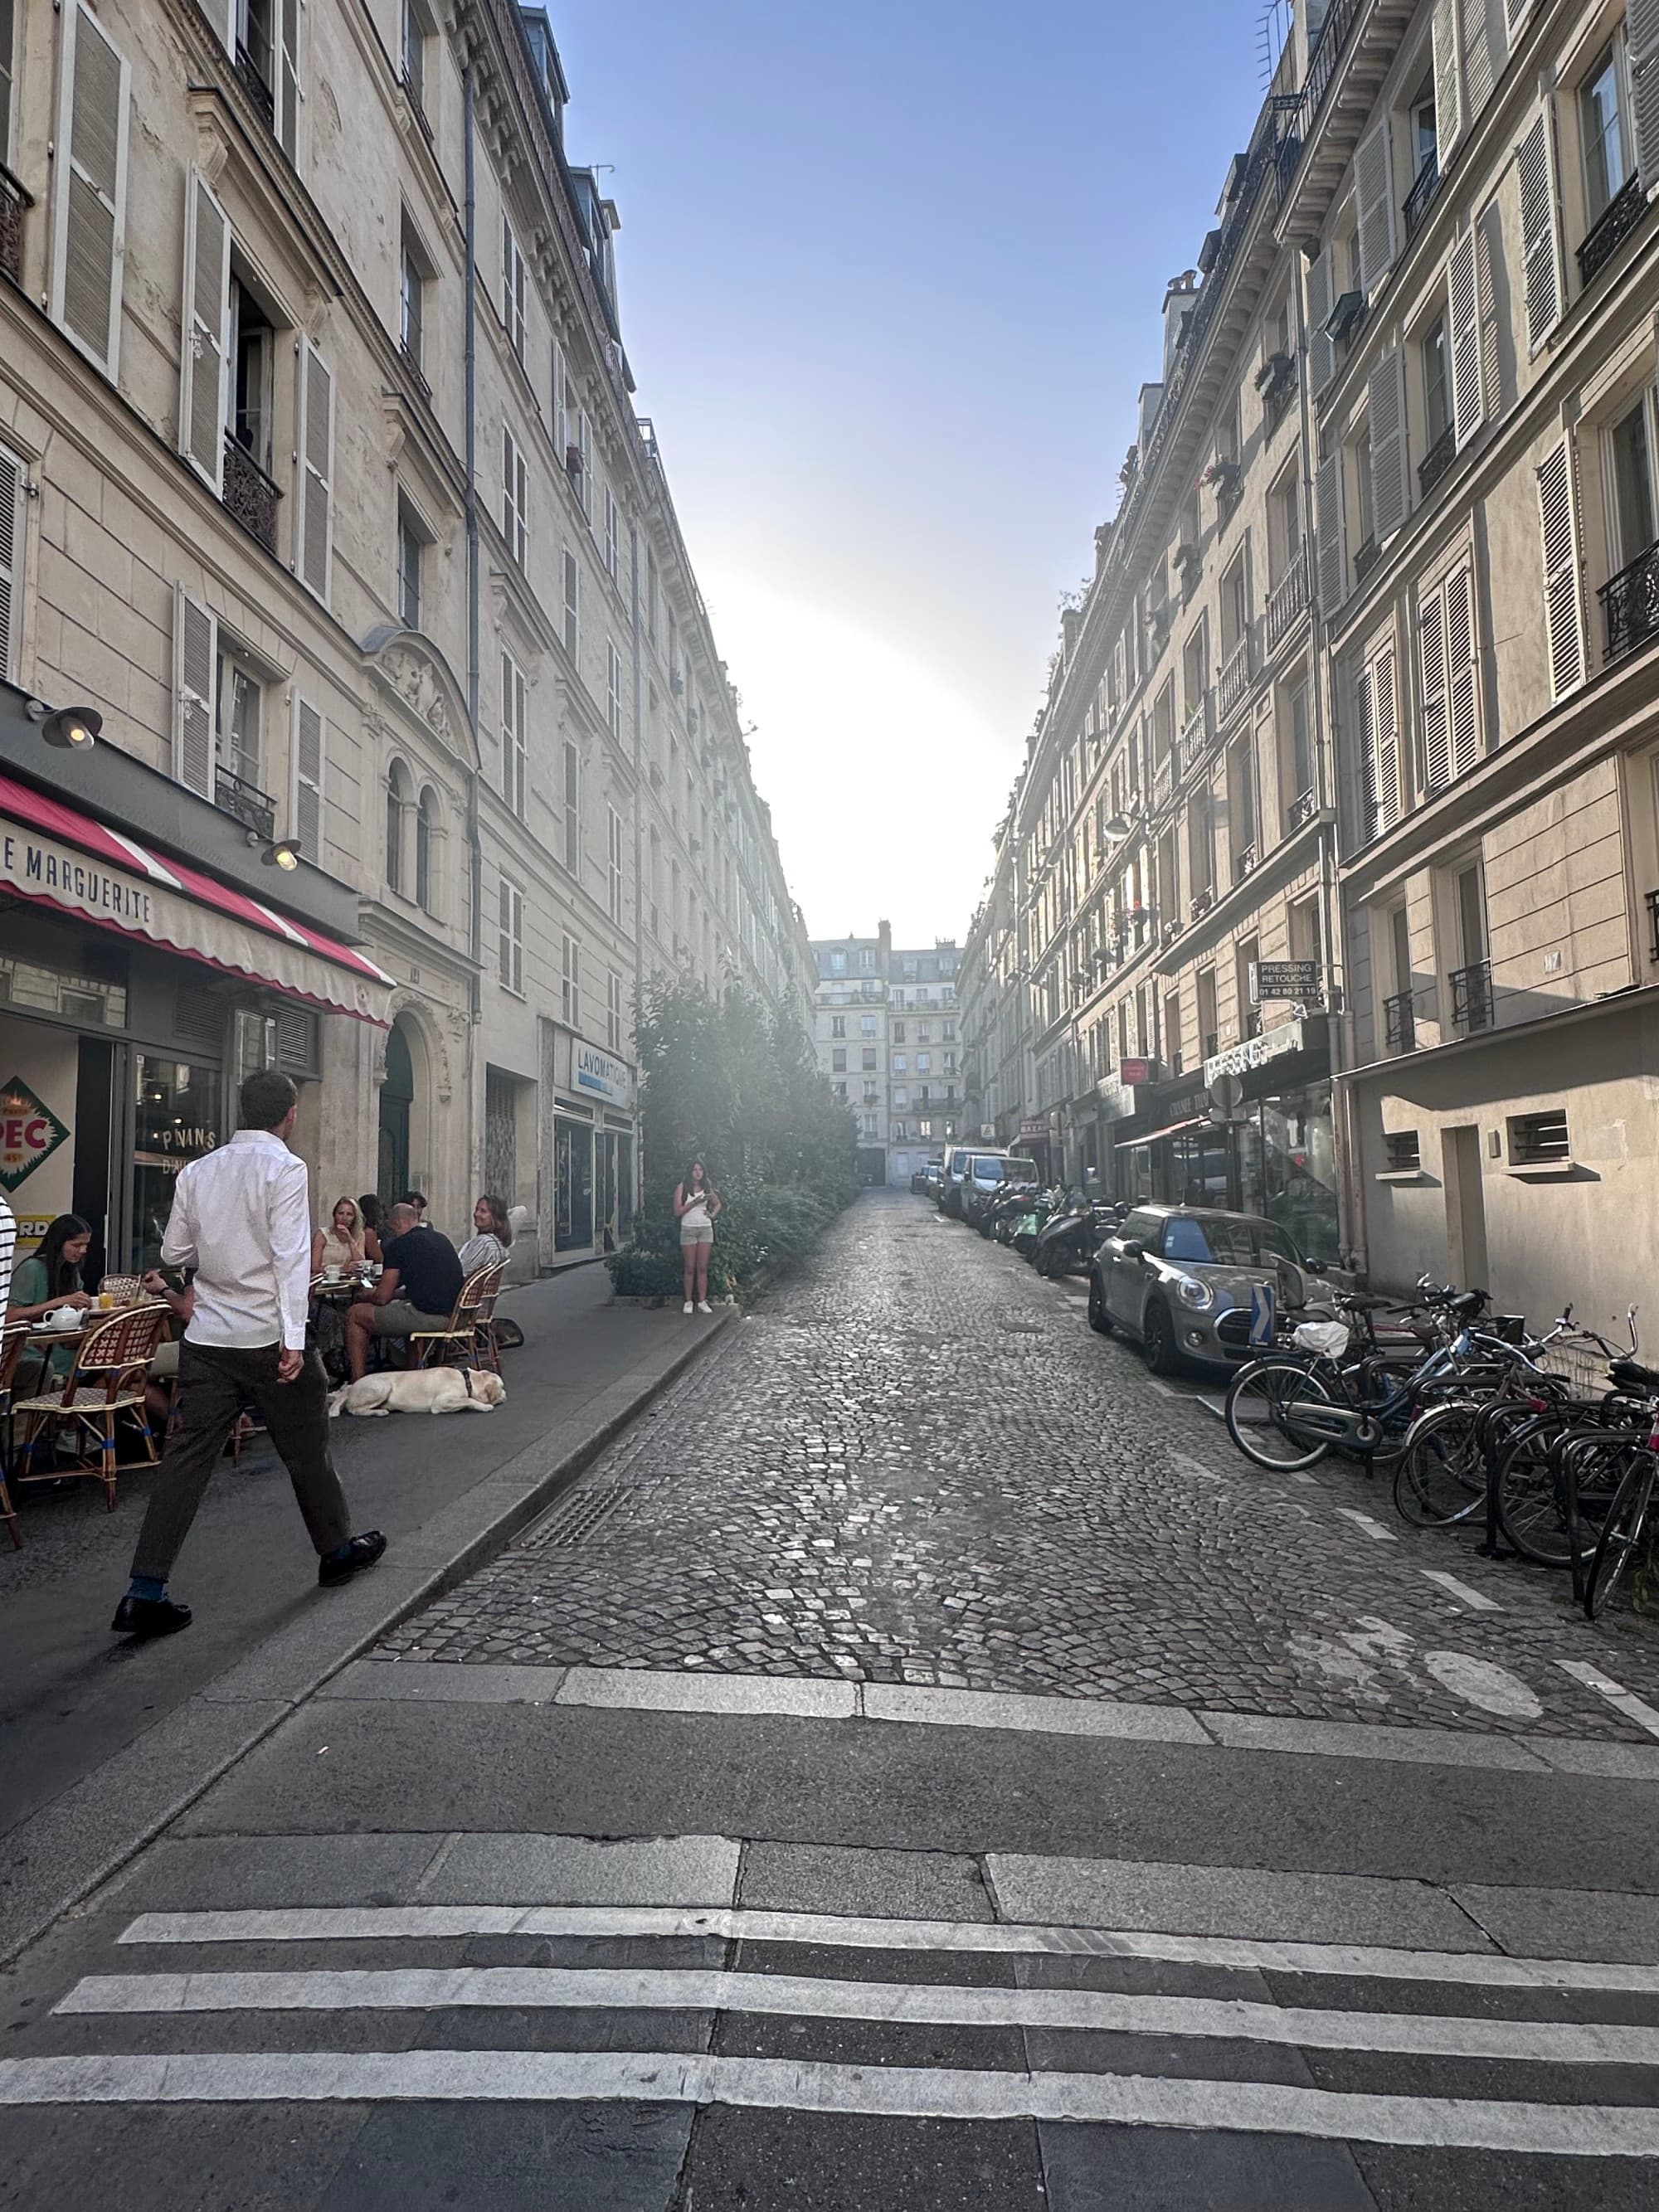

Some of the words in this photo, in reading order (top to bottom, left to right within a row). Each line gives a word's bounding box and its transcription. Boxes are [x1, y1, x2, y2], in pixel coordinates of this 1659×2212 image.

[26, 846, 150, 923] MARGUERITE
[1261, 964, 1311, 973] PRESSING
[1294, 987, 1304, 995] 21
[578, 1048, 625, 1089] LAVOMATIQUE
[0, 1119, 47, 1149] EC
